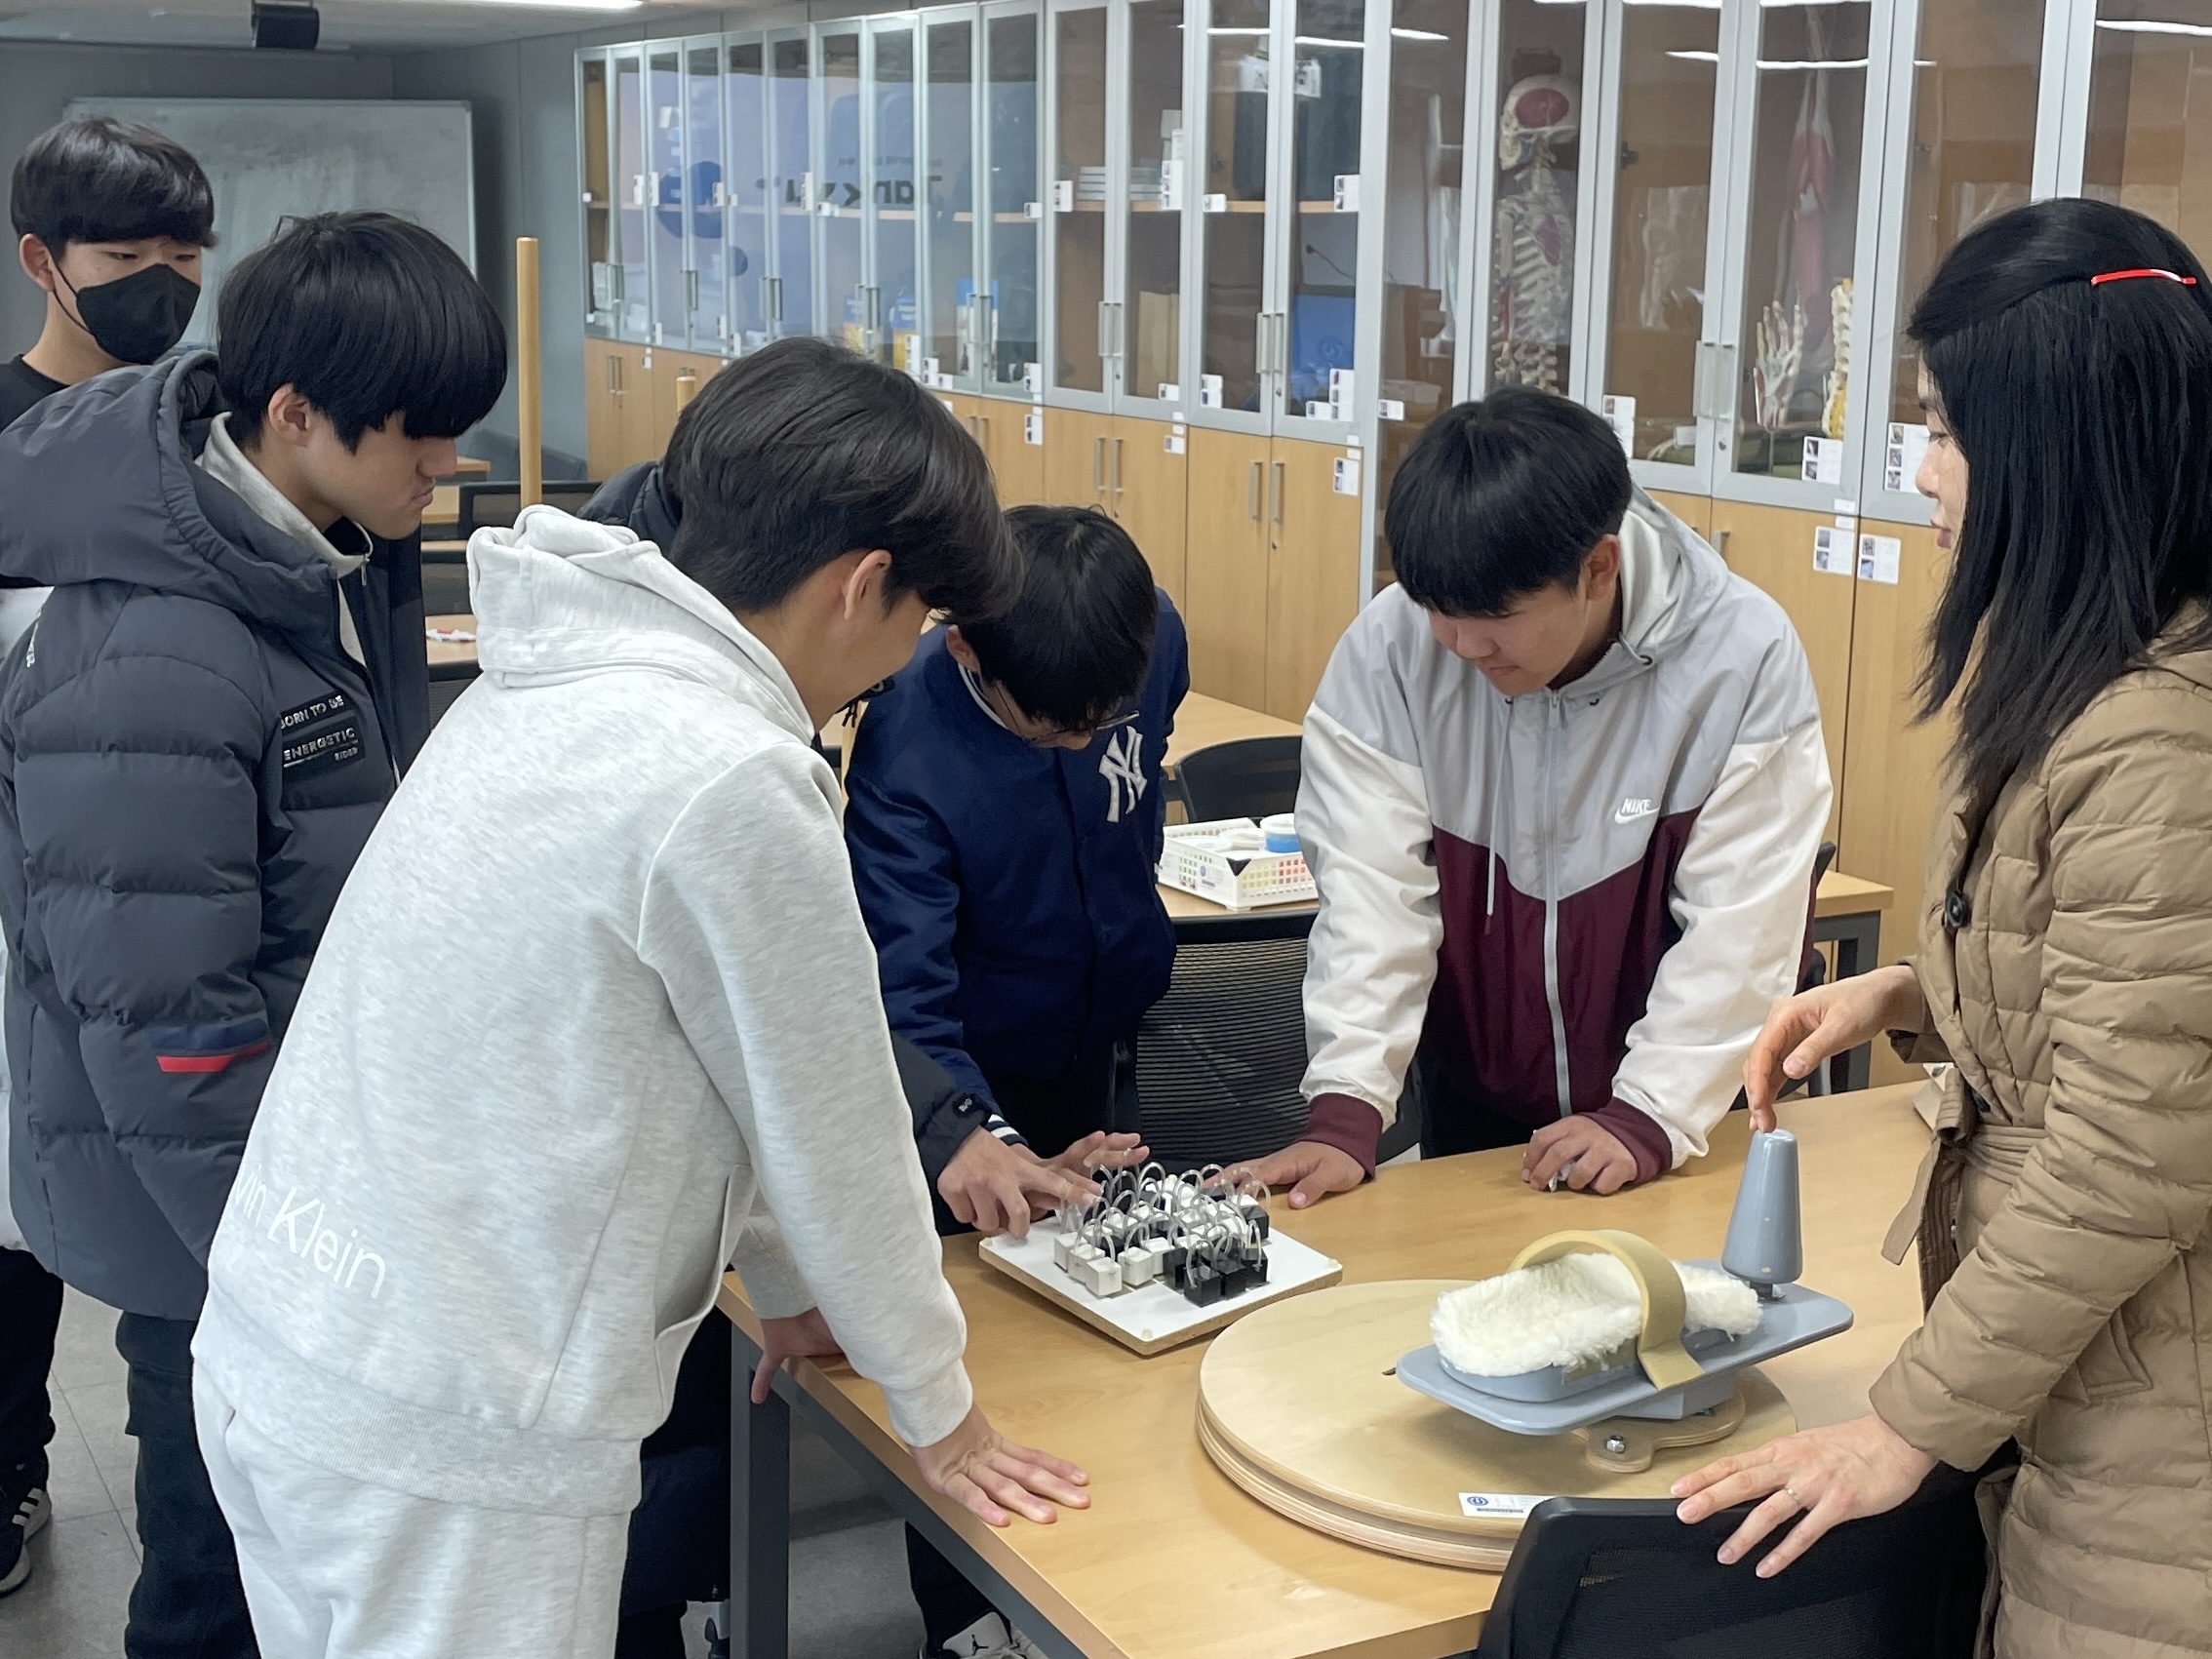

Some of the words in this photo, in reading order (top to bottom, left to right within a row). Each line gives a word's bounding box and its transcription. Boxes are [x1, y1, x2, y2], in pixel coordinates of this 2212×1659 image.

[309, 702, 327, 716] TO
[283, 728, 355, 761] ENERGETIC
[1098, 725, 1147, 823] NY
[1621, 798, 1651, 813] NIKE
[266, 1185, 387, 1300] Klein
